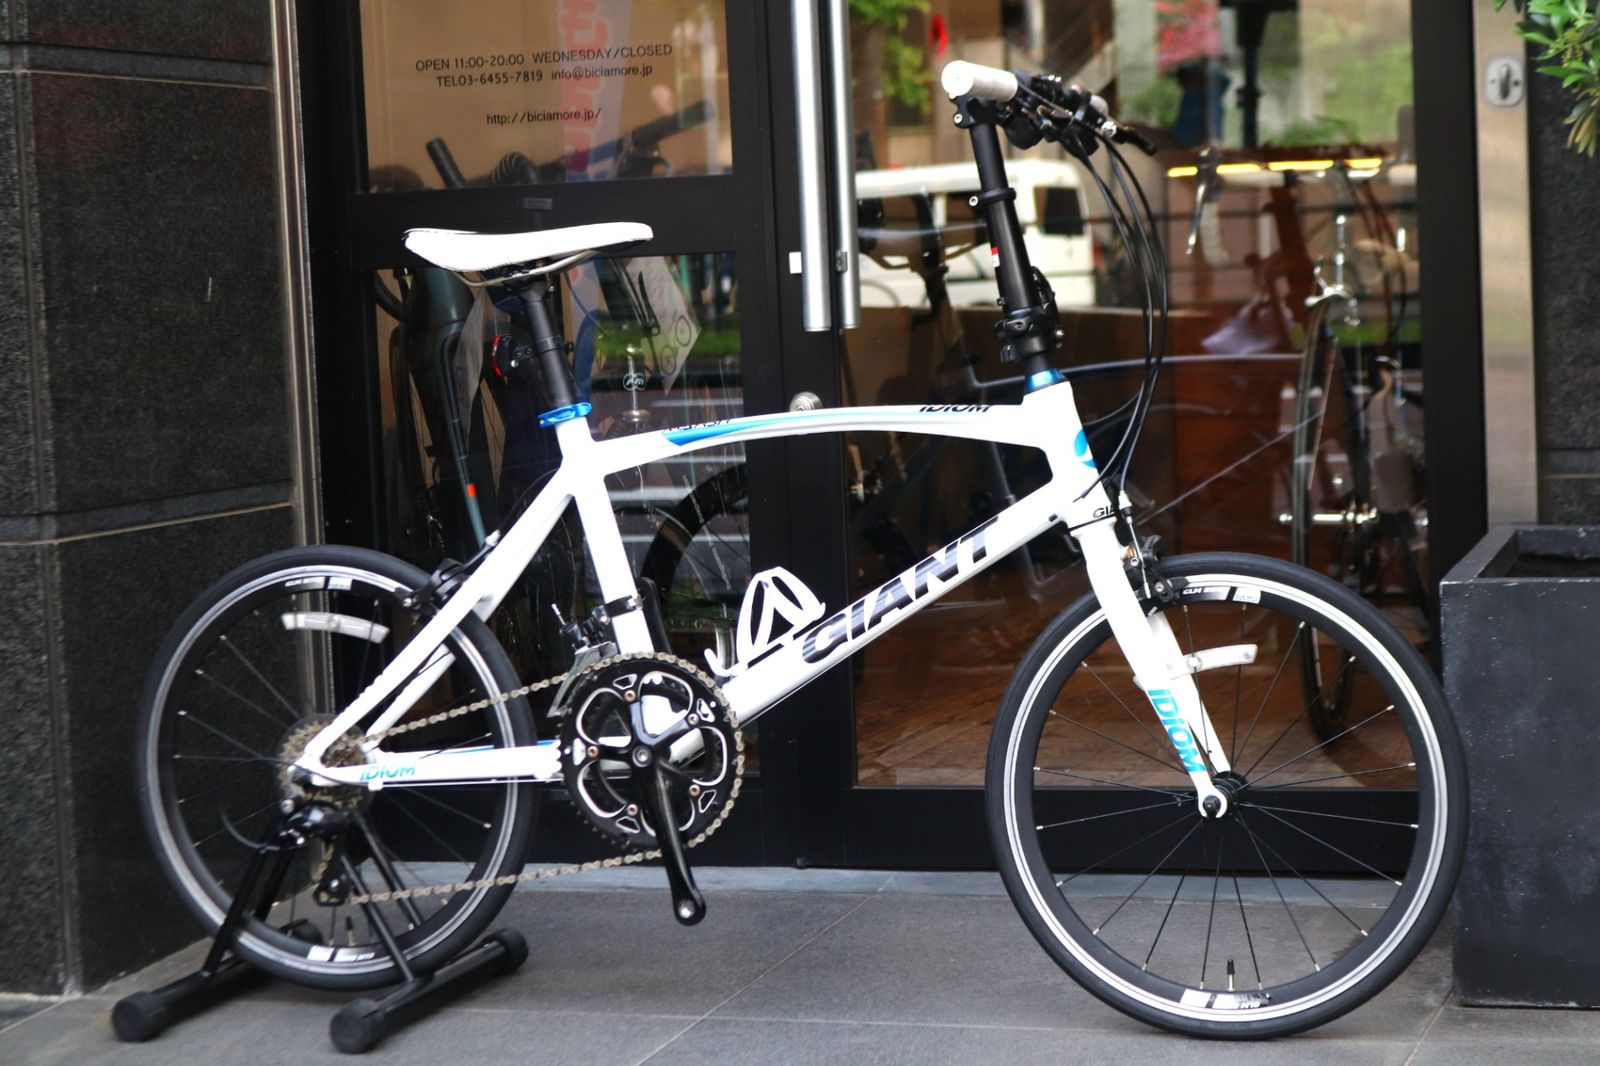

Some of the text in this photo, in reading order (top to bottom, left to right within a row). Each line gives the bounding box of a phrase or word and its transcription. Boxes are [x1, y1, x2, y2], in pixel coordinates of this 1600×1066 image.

[415, 44, 673, 72] OPEN 11:00-20:00 WEDNESDAY/CLOSED
[436, 64, 653, 88] TEL03-6455-7819 info@biciamore.jp
[486, 107, 602, 126] http://biciamore.jp/
[802, 515, 999, 664] GIANT
[1147, 689, 1207, 772] IDIOM
[360, 765, 416, 780] IDIOM
